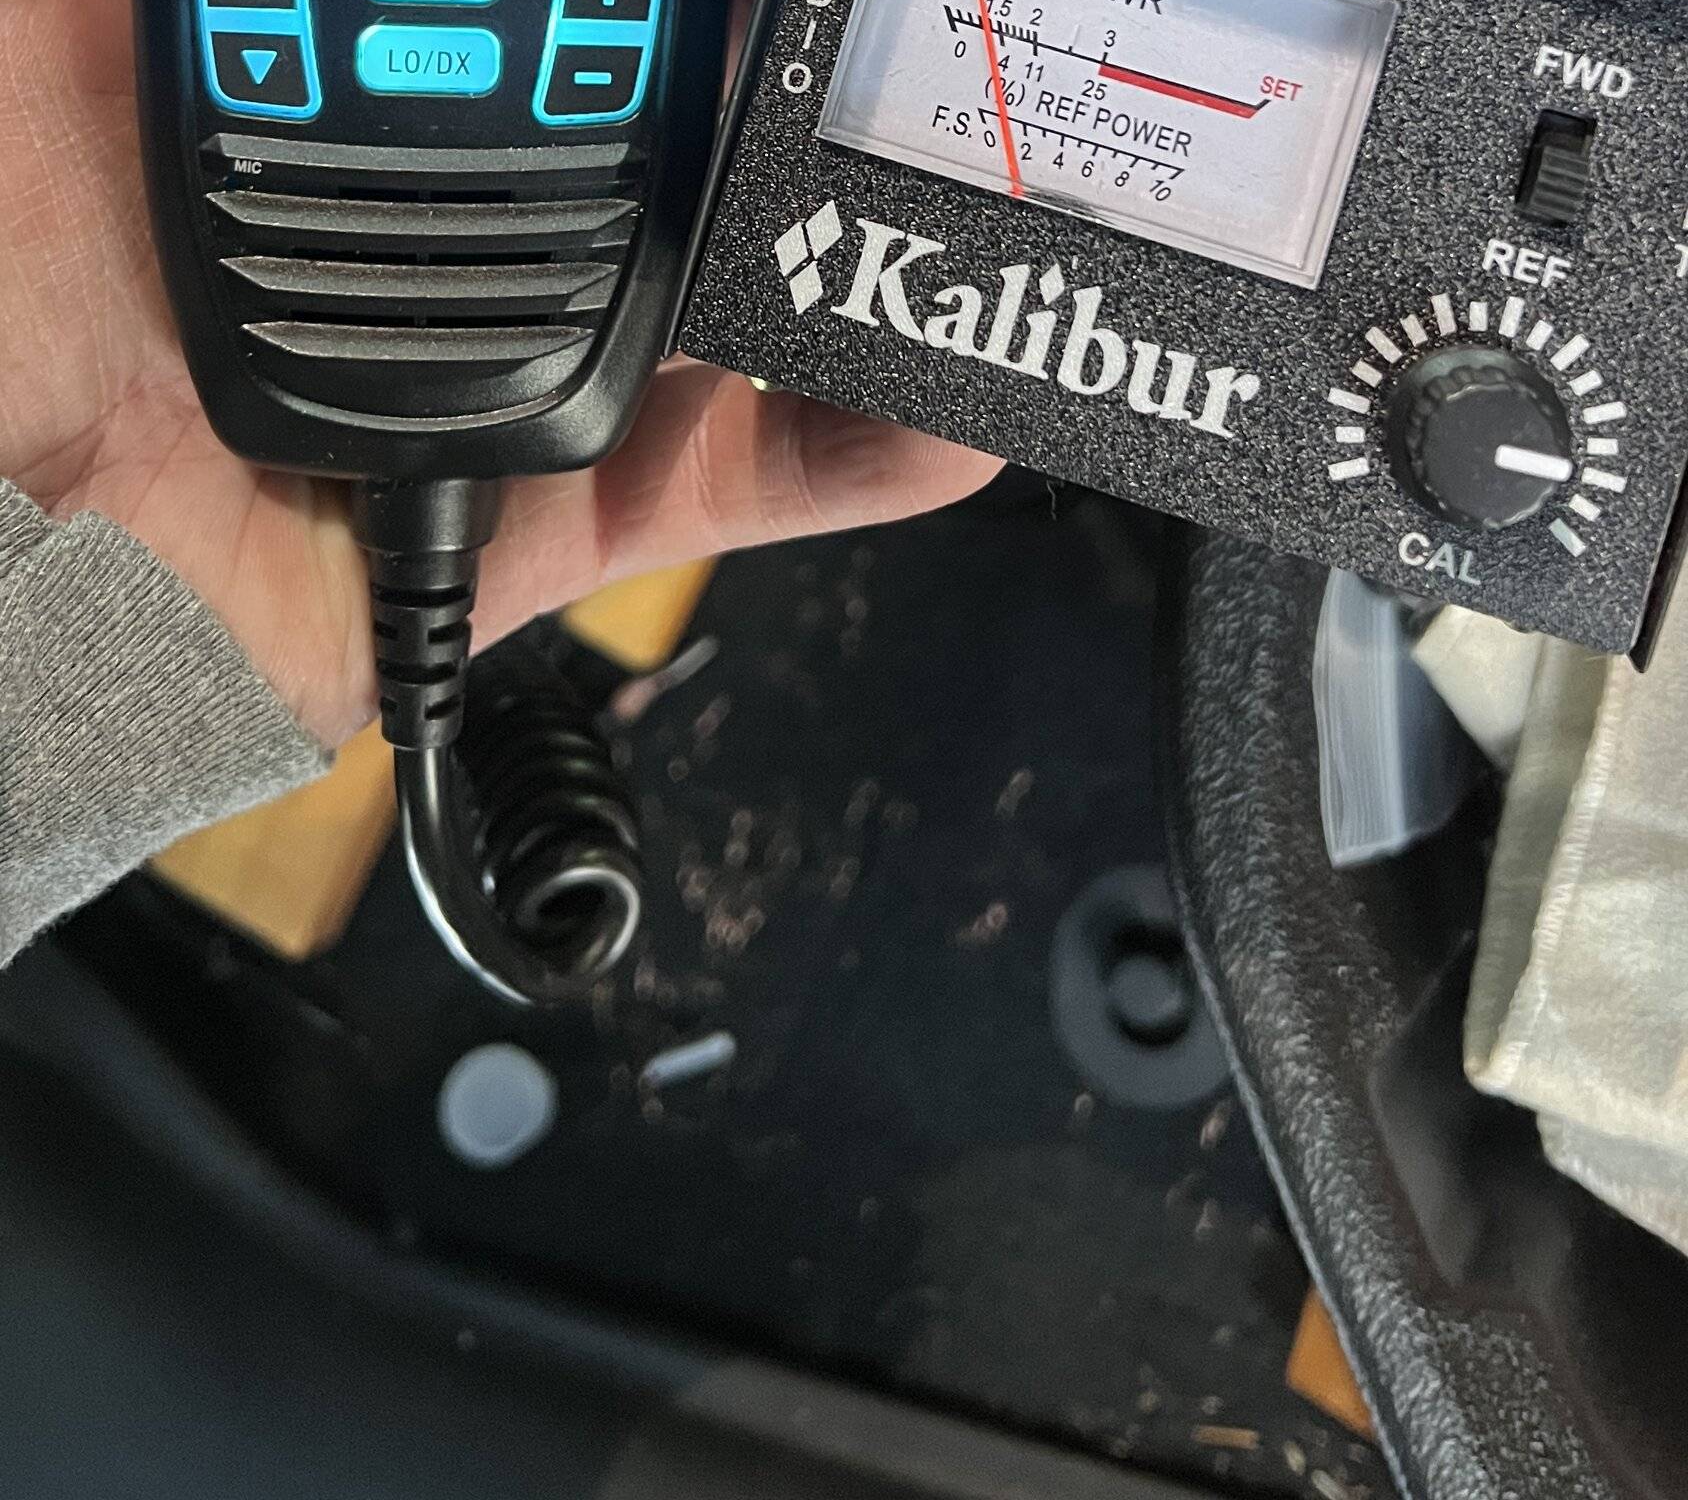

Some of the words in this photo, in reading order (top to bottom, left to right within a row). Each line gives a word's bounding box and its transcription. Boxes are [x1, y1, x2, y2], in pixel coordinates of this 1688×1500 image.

[1029, 8, 1043, 26] 2
[1103, 30, 1116, 47] 3
[387, 50, 472, 76] LO/DX
[954, 40, 966, 58] 0
[997, 55, 1010, 72] 4
[1024, 62, 1044, 82] 11
[1082, 79, 1107, 100] 25
[1260, 75, 1303, 102] SET
[1533, 45, 1632, 99] FWD
[932, 105, 972, 138] F.S.
[1036, 90, 1090, 124] REF
[1092, 107, 1192, 157] POWER
[234, 159, 263, 175] MIC
[984, 130, 996, 148] 0
[1020, 143, 1032, 160] 2
[1053, 152, 1064, 170] 4
[1081, 161, 1094, 178] 6
[1115, 171, 1129, 187] 8
[1149, 179, 1171, 202] 10
[1481, 239, 1571, 289] REF
[830, 217, 1260, 439] Kalibur
[1397, 530, 1482, 586] CAL
